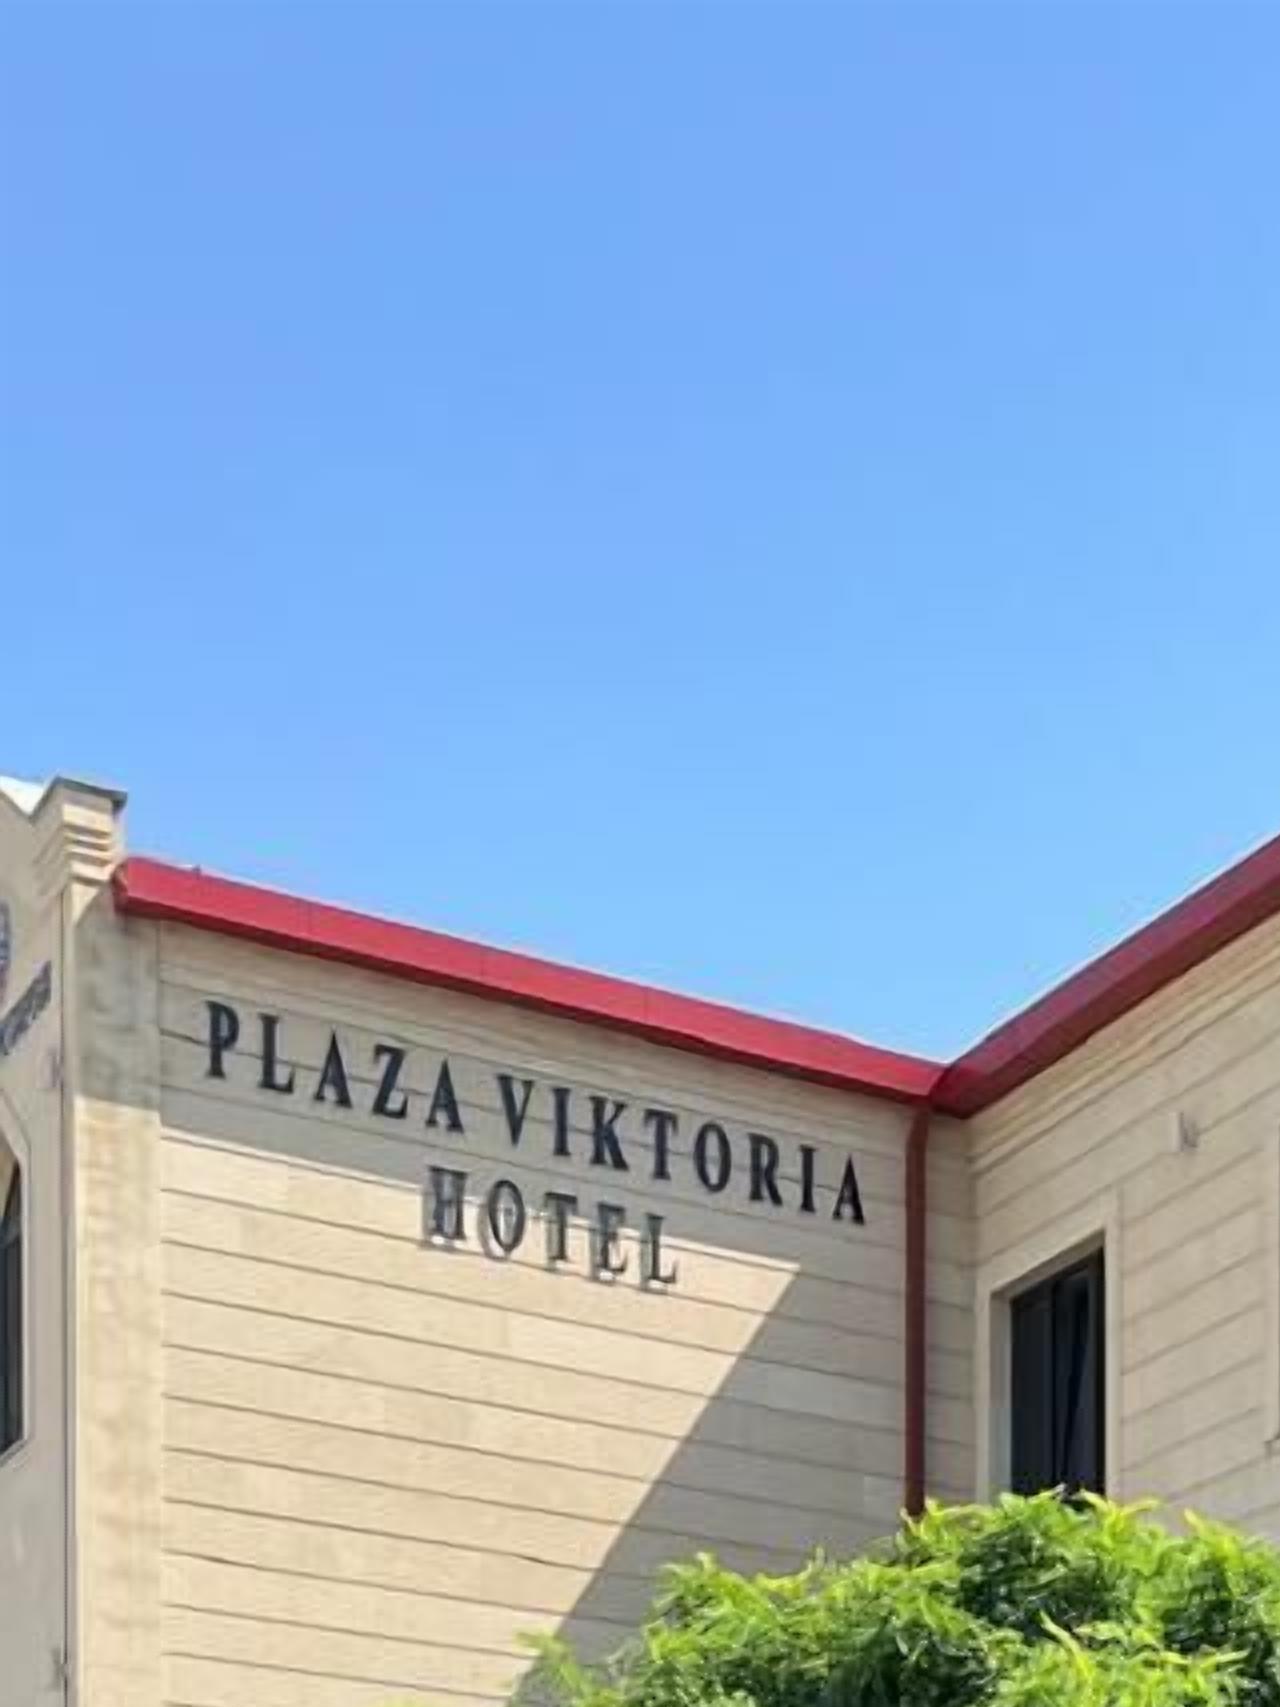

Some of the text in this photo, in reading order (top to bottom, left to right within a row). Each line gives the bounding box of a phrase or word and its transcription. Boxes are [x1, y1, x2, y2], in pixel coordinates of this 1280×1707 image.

[205, 1000, 464, 1134] PLAZA
[496, 1073, 866, 1225] VIKTORIA
[427, 1165, 679, 1285] HOTEL
